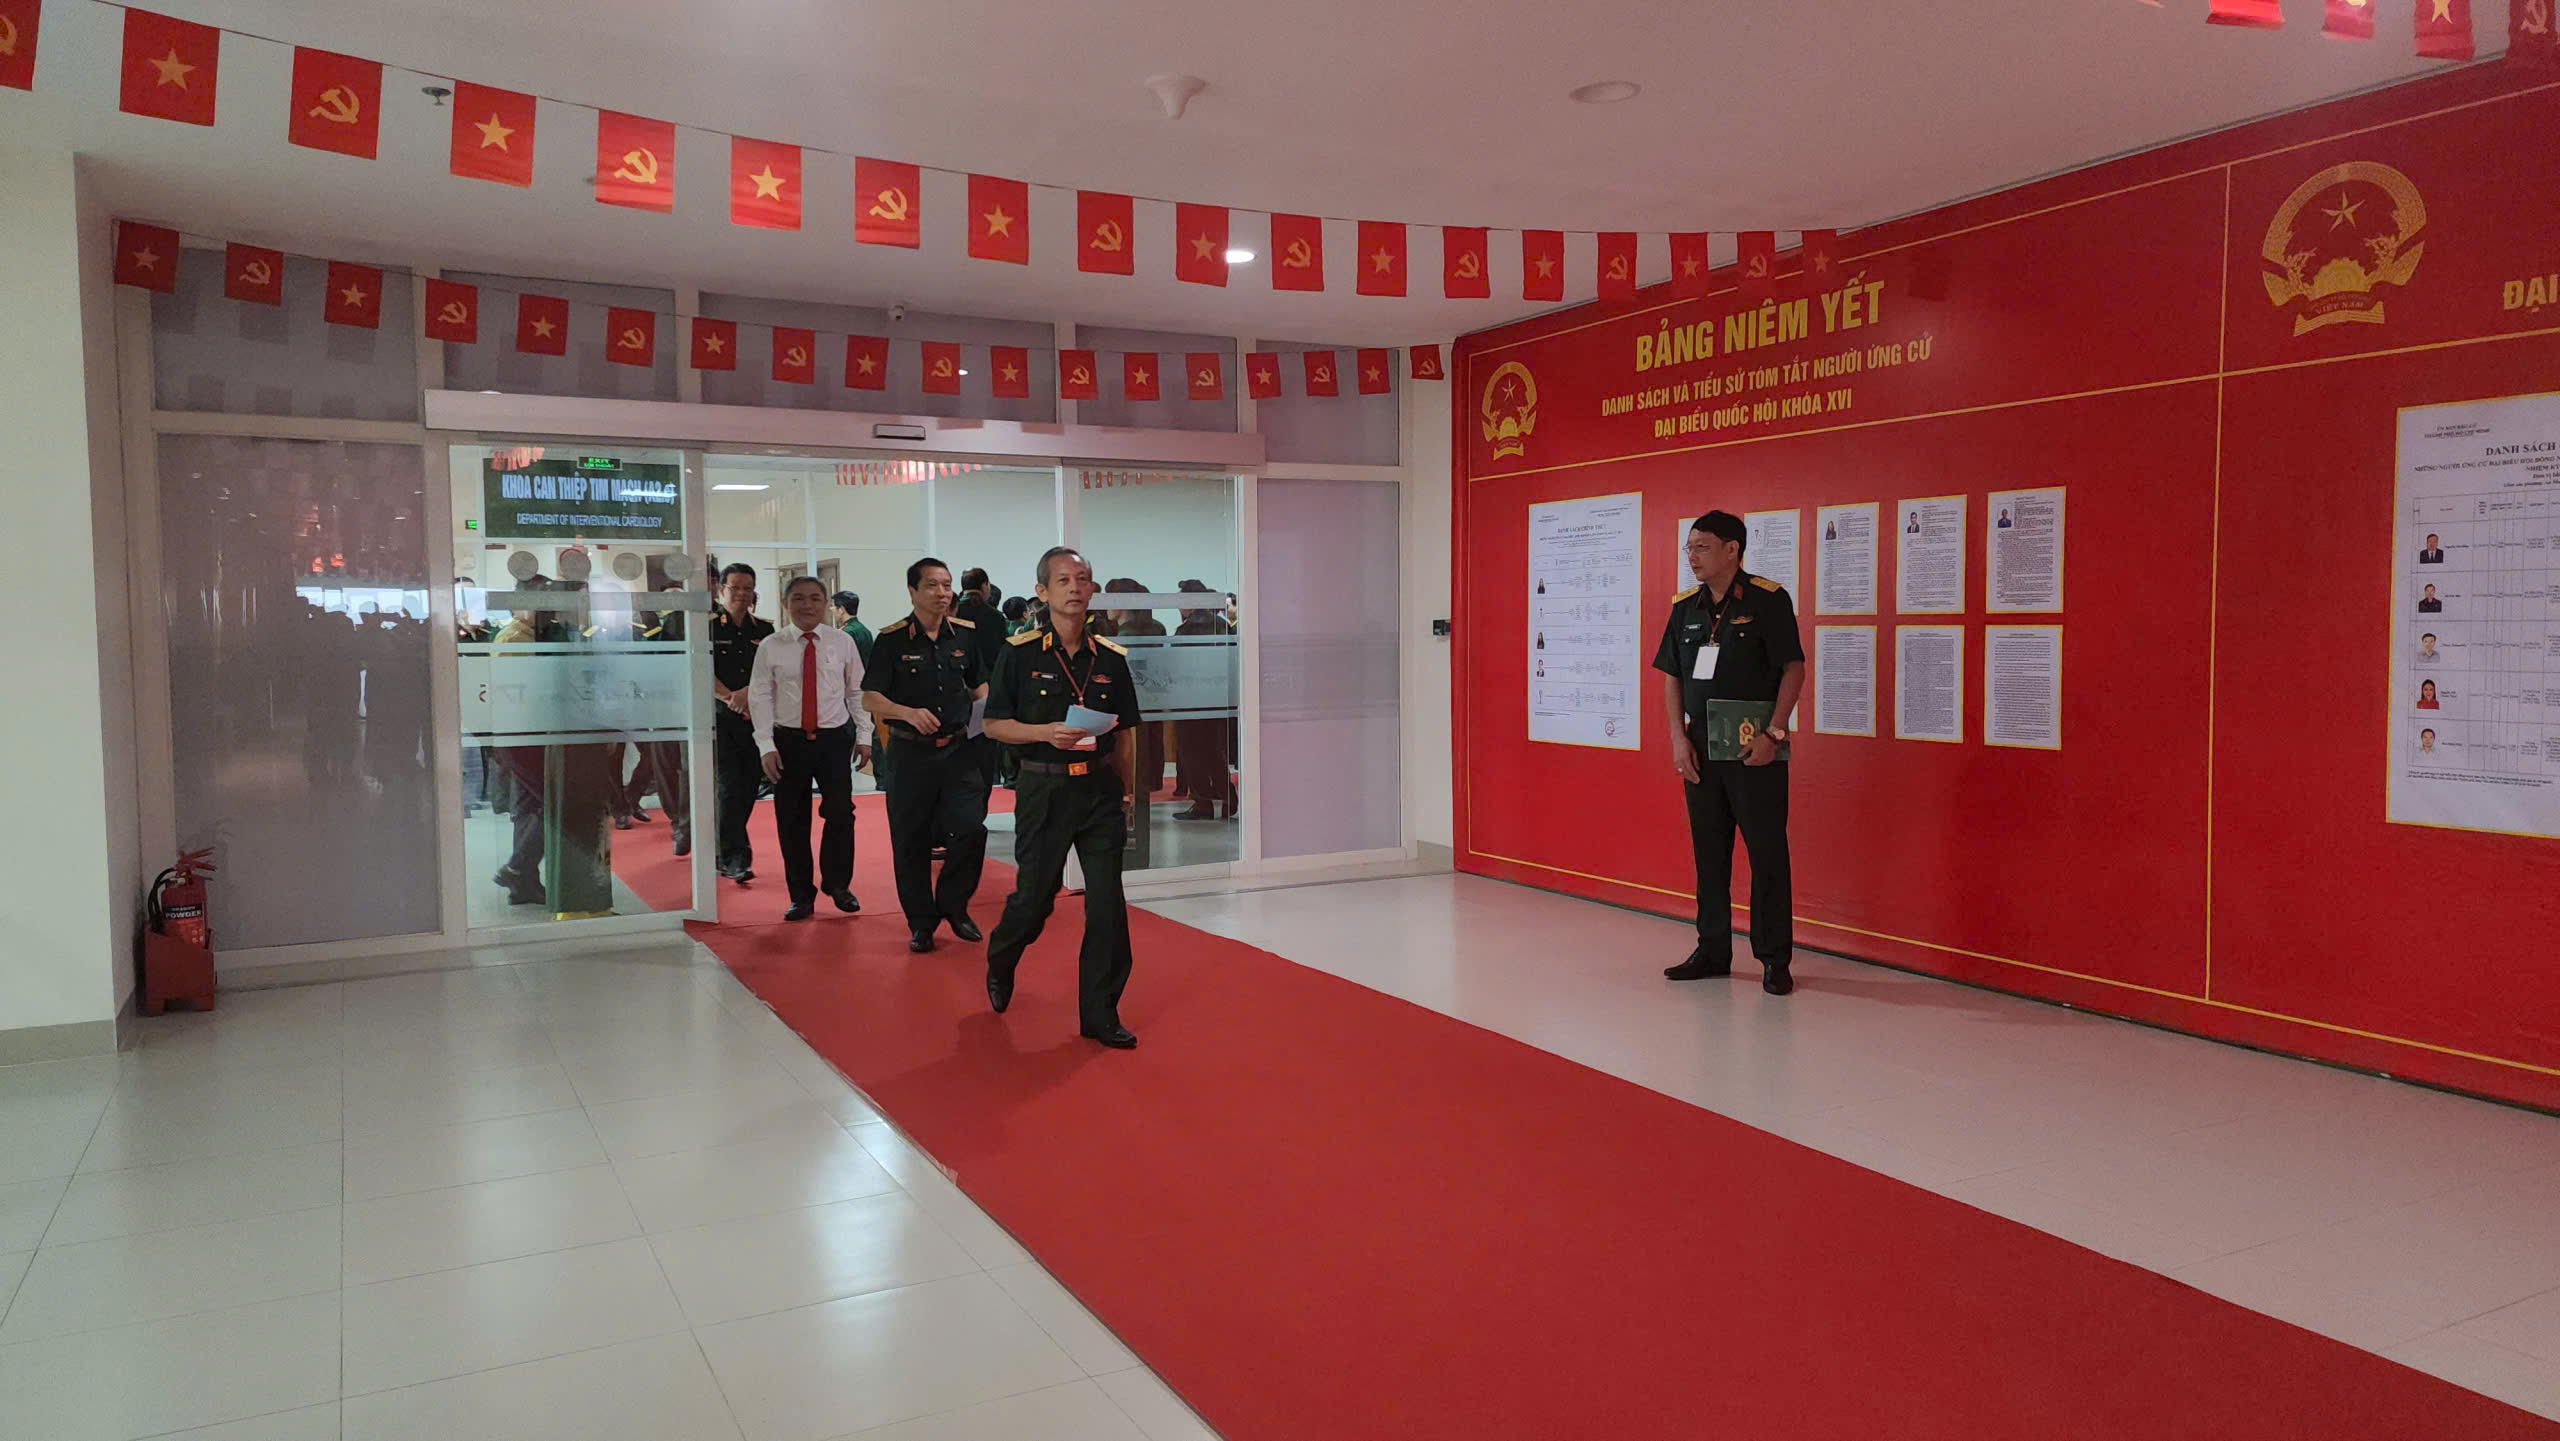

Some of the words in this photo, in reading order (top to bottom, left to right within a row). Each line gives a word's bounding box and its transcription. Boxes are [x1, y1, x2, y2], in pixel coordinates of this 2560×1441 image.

[2503, 274, 2559, 313] ĐẠI
[1636, 318, 1714, 372] BẢNG
[1724, 297, 1809, 354] NIÊM
[1820, 270, 1885, 333] YẾT
[1601, 394, 1634, 417] DANH
[1637, 386, 1670, 411] SÁCH
[1673, 380, 1690, 404] VÀ
[1692, 371, 1722, 401] TIỂU
[1725, 367, 1746, 395] SỬ
[1747, 366, 1779, 391] TÓM
[1782, 354, 1809, 385] TẮT
[1813, 347, 1862, 380] NGƯỜI
[1866, 343, 1902, 369] ỨNG
[1907, 331, 1934, 363] CỬ
[1654, 417, 1676, 440] ĐẠI
[1679, 406, 1709, 435] BIỂU
[1712, 399, 1750, 431] QUỐC
[1753, 397, 1777, 426] HỘI
[1781, 391, 1823, 419] KHÓA
[1826, 388, 1853, 412] XVI
[2486, 445, 2520, 456] DANH
[2522, 441, 2556, 453] SÁCH
[502, 474, 532, 499] KHOA
[533, 475, 557, 500] CAN
[557, 471, 588, 505] THIỆP
[588, 477, 609, 501] TIM
[516, 513, 559, 525] DEPARTMENT
[560, 513, 569, 526] OF
